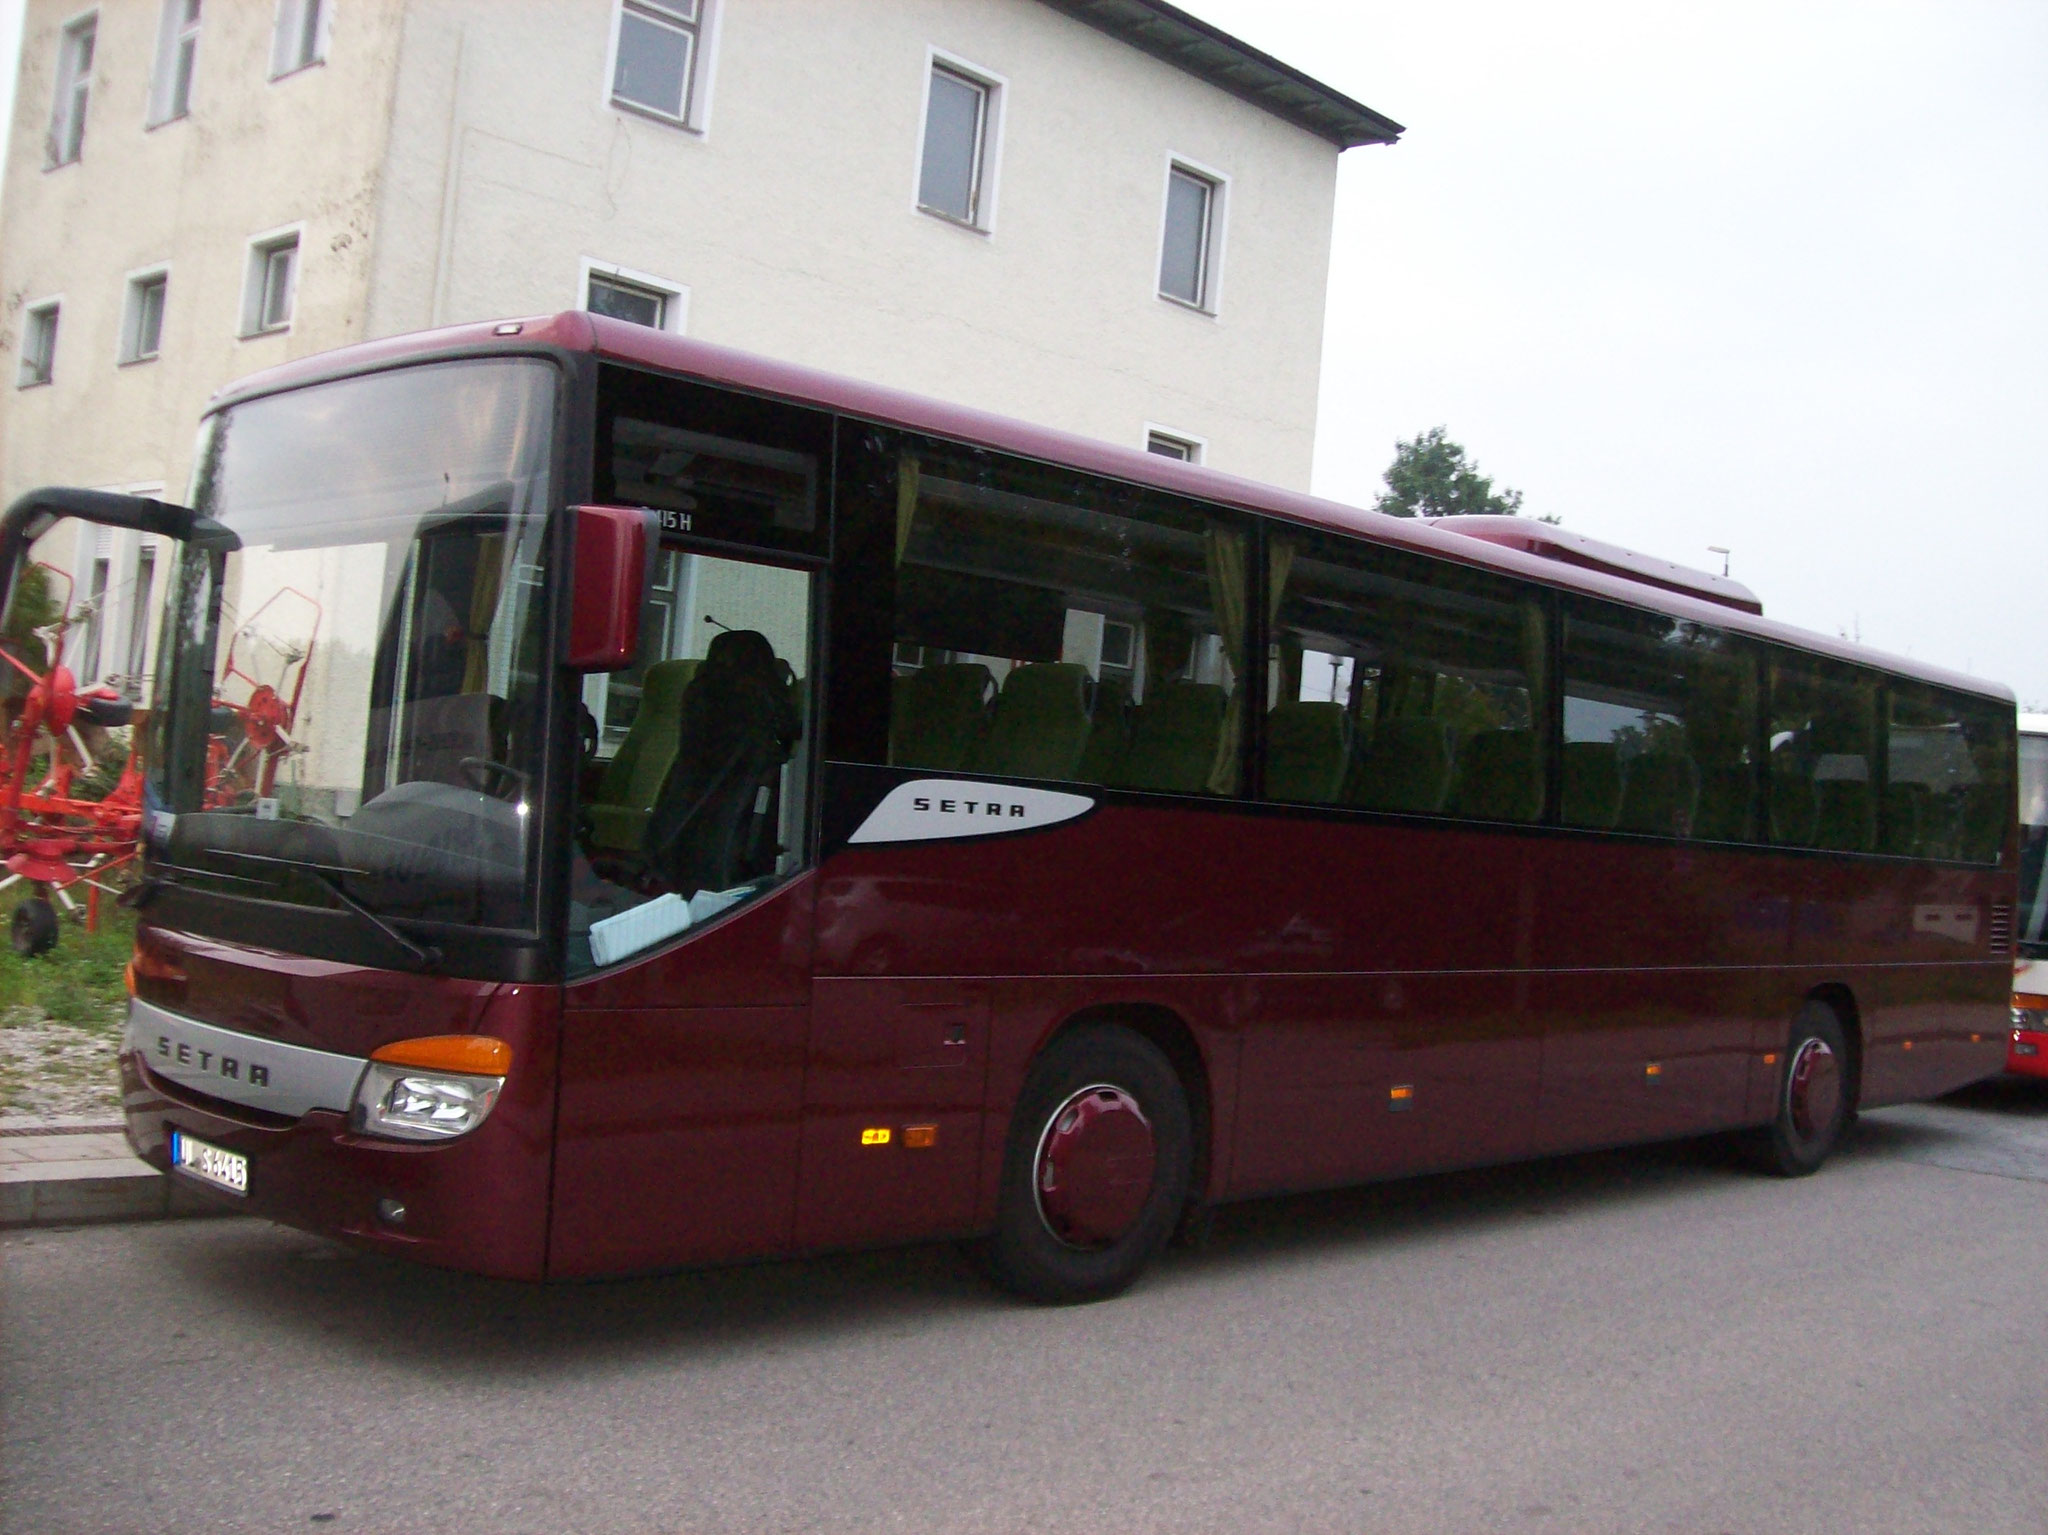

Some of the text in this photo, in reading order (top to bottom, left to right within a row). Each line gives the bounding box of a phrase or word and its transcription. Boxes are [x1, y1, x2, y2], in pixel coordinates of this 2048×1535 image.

[679, 512, 692, 532] H
[912, 797, 1025, 818] SETRA
[157, 1036, 269, 1088] SETRA
